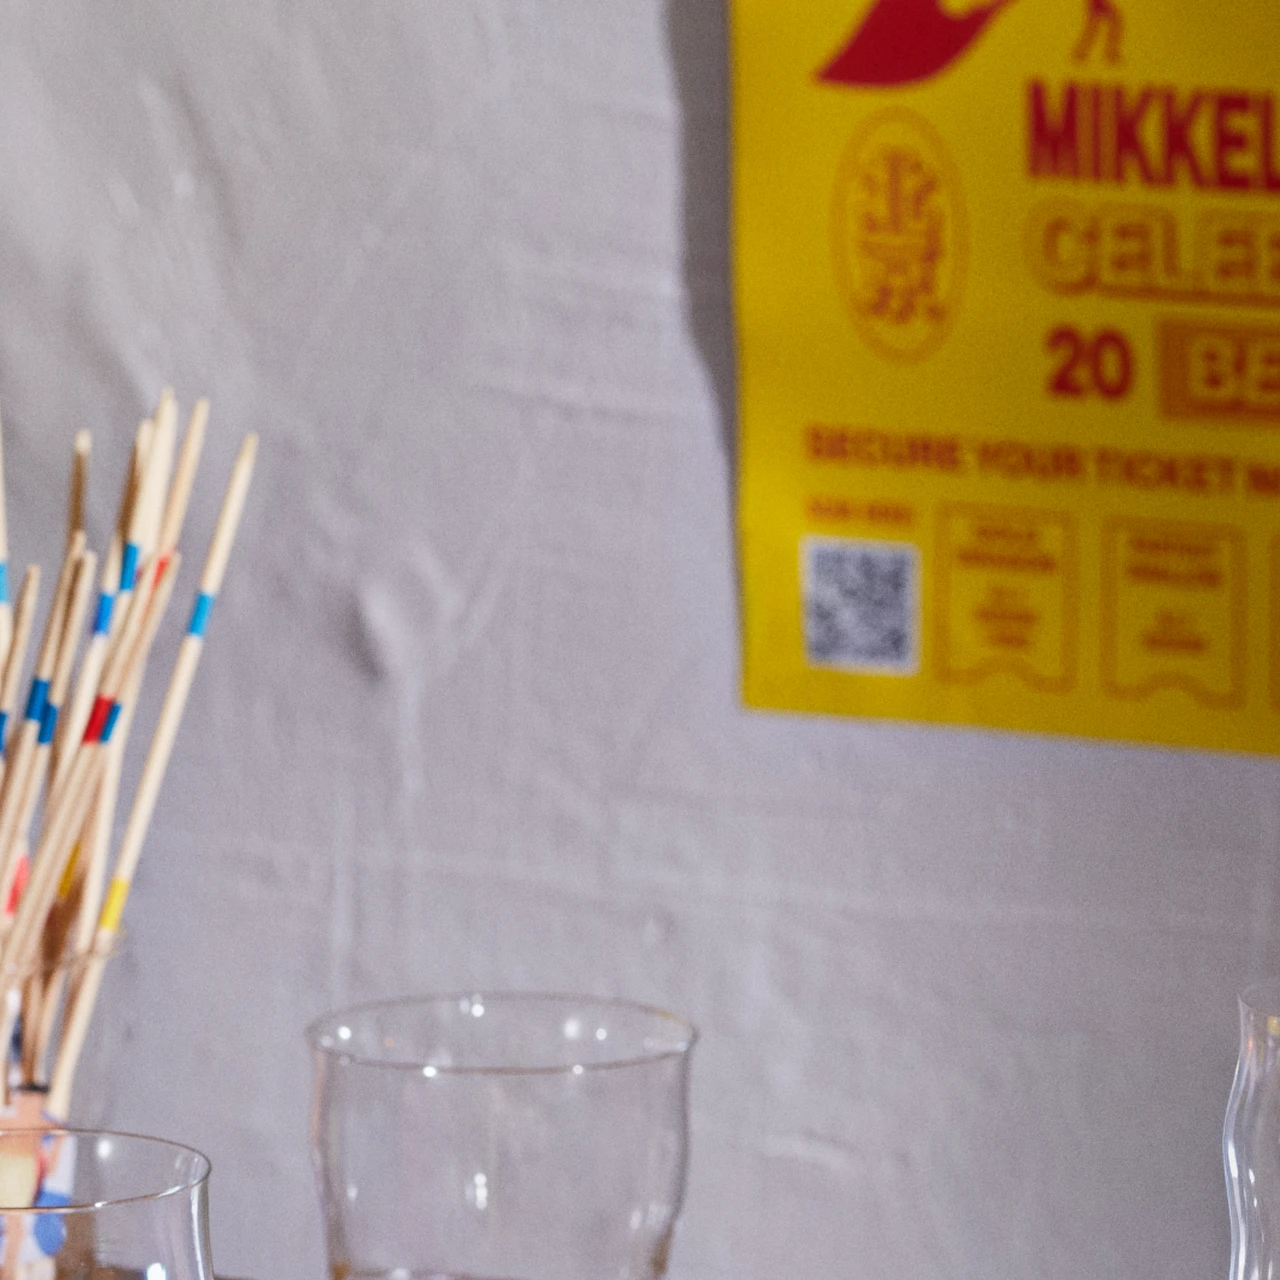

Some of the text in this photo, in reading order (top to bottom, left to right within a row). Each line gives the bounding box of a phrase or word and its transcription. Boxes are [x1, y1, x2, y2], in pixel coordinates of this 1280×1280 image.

[1045, 325, 1136, 399] 20
[804, 424, 963, 474] SECURE
[975, 437, 1085, 486] YOUR
[1094, 446, 1237, 495] TICKET
